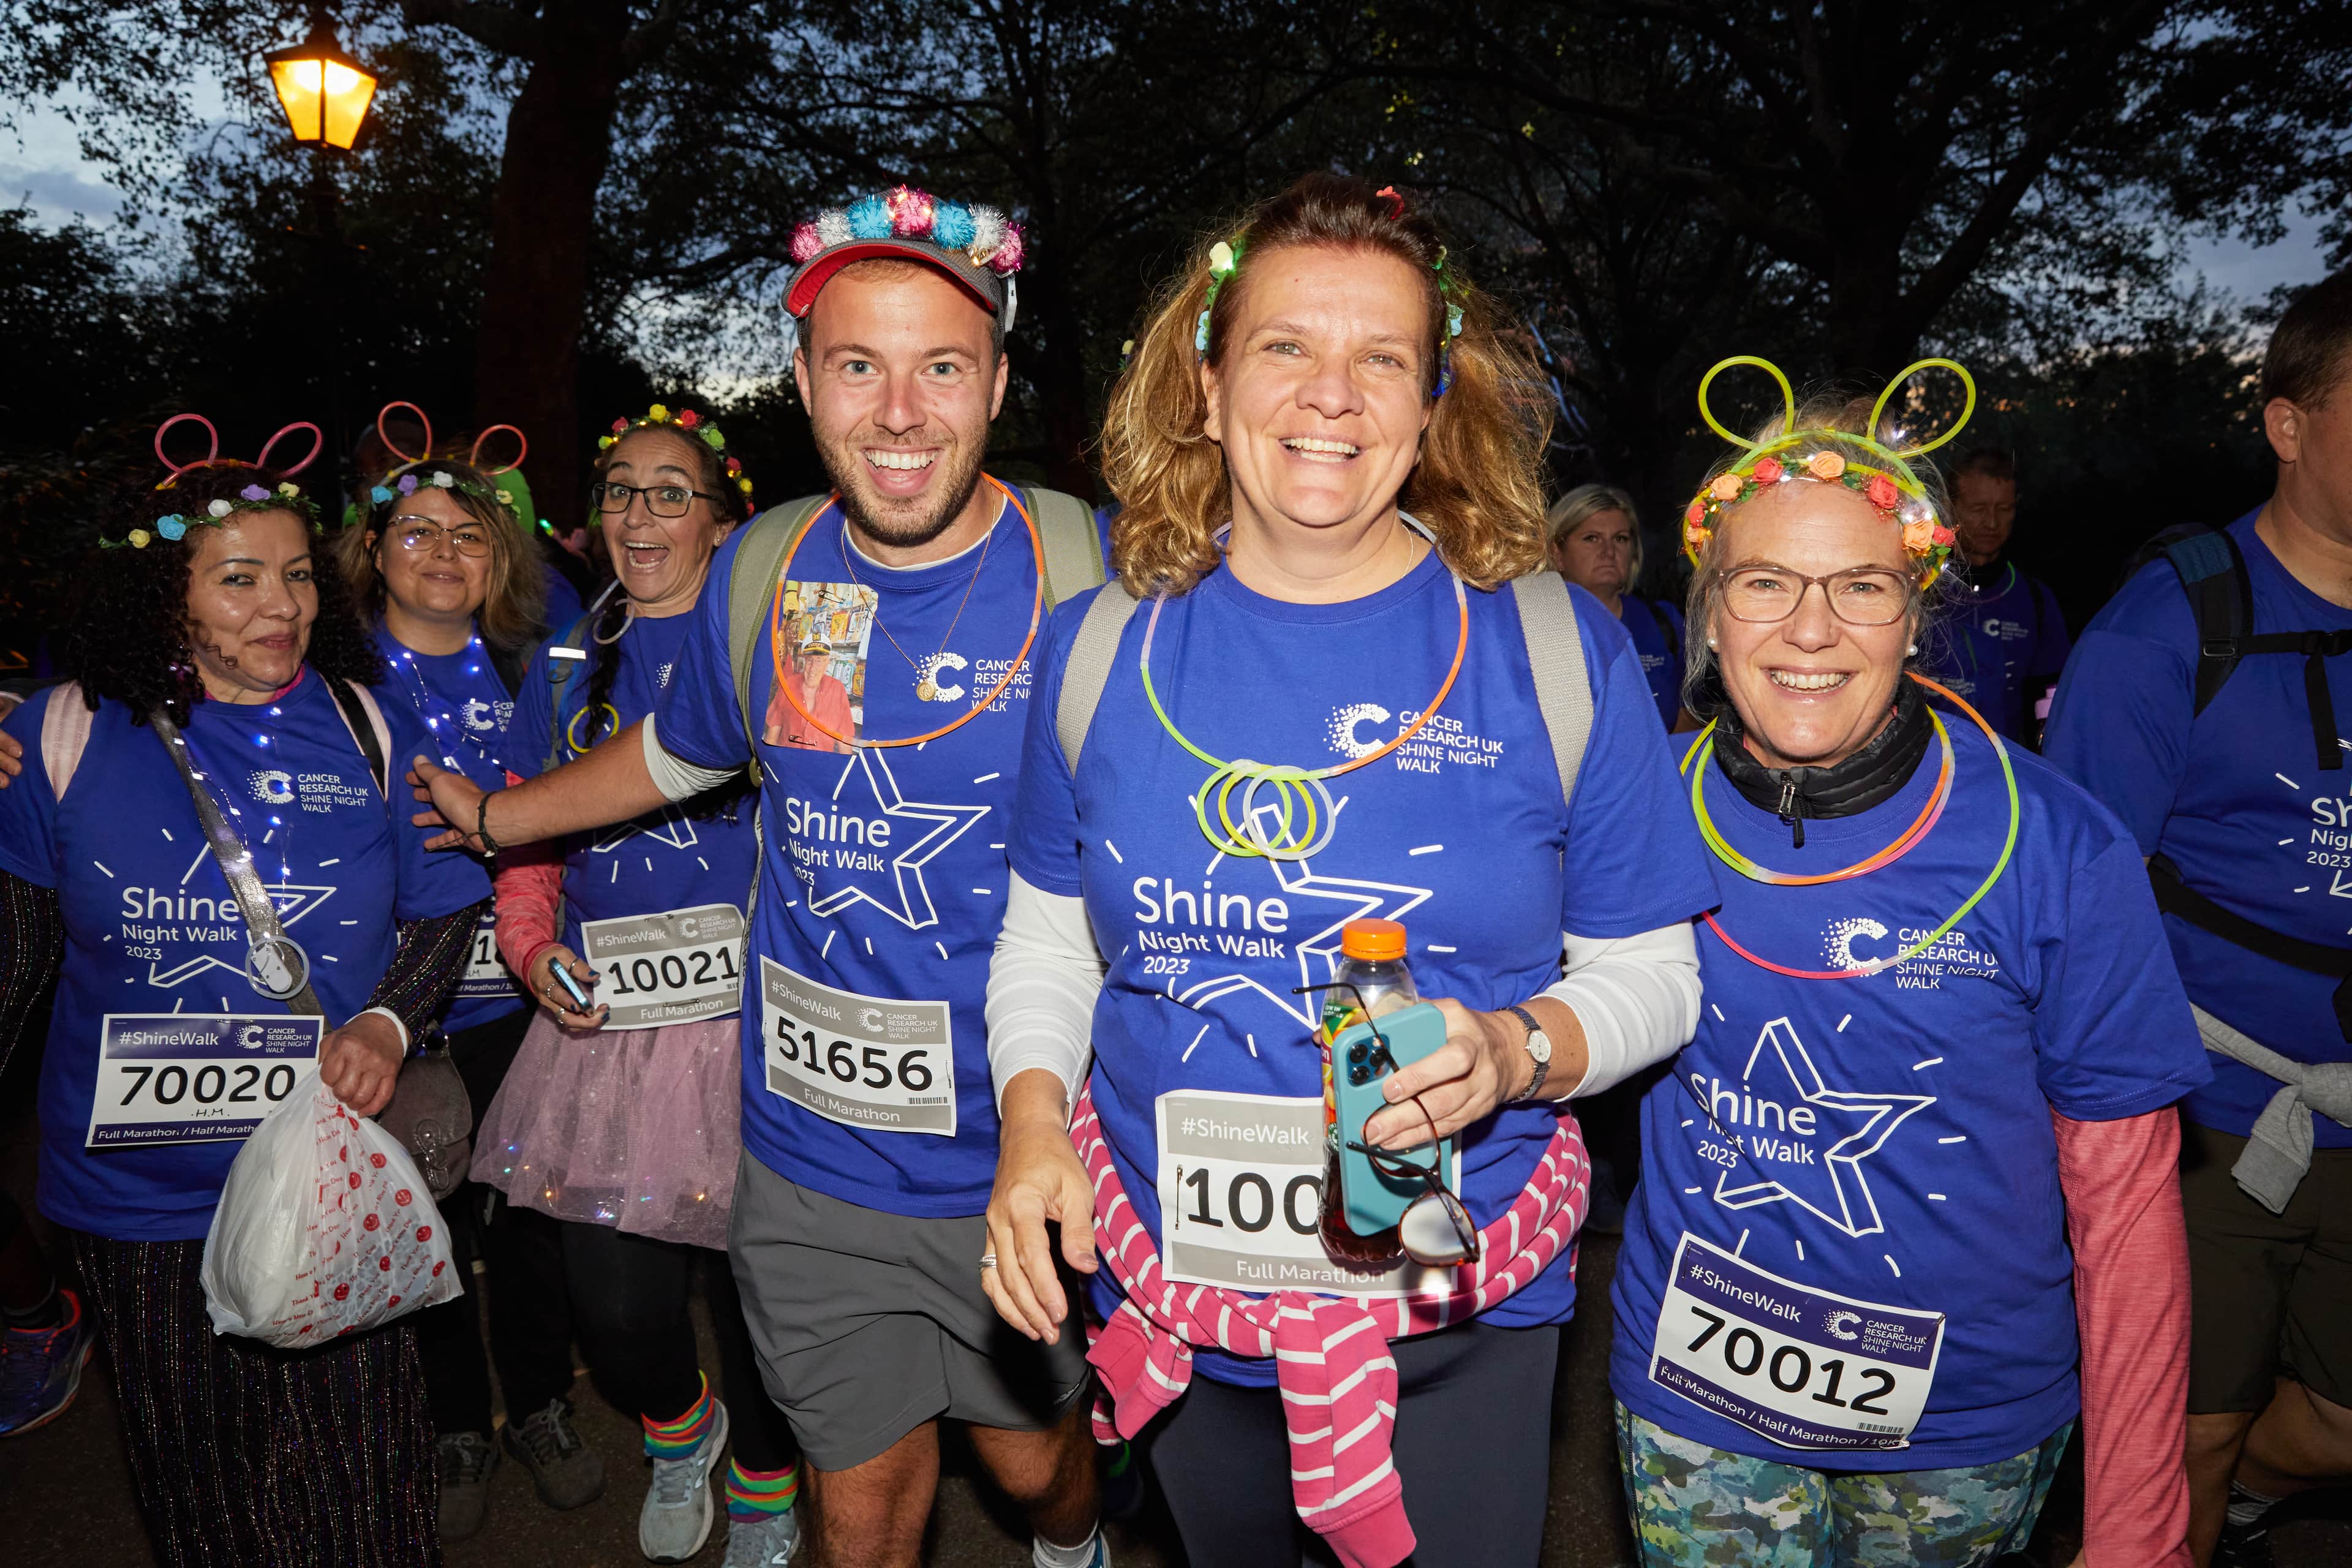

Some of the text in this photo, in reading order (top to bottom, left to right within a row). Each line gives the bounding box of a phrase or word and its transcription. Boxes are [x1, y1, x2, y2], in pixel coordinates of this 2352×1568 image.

[1396, 743, 1498, 767] SHINE NIGHT
[1482, 739, 1504, 753] UK
[1396, 758, 1440, 774] WALK
[298, 774, 341, 784] CANCER
[299, 784, 369, 796] RESEARCH UK
[301, 795, 366, 807] SHINE NIGHT
[301, 804, 332, 813] WALK
[786, 797, 891, 847] Shine
[2311, 829, 2352, 851] Nig
[789, 838, 884, 873] Night Walk
[2307, 851, 2351, 868] 2023
[122, 887, 239, 921] Shine
[1133, 876, 1289, 933] Shine
[122, 924, 237, 944] Night Walk
[596, 929, 667, 947] #ShineWalk
[124, 946, 162, 960] 2023
[1139, 930, 1285, 959] Night Walk
[1143, 956, 1191, 974] 2023
[1985, 953, 1999, 966] U
[608, 946, 739, 994] 10021
[1896, 962, 1999, 979] SHINE NIGHT
[1896, 976, 1940, 990] WALK
[641, 1000, 723, 1019] Full Marathon
[771, 979, 842, 1021] #ShineWalk
[119, 1031, 219, 1046] #ShineWalk
[777, 1016, 933, 1091] 51656
[120, 1065, 296, 1106] 70020
[804, 1088, 900, 1123] Full Marathon
[1691, 1073, 1817, 1136] Shine
[98, 1130, 122, 1139] Full
[190, 1126, 214, 1136] Half
[1181, 1117, 1309, 1145] #ShineWalk
[1697, 1140, 1738, 1168] 2023
[1752, 1136, 1814, 1164] Walk
[1236, 1260, 1384, 1283] Full Marathon
[1690, 1264, 1801, 1323] #ShineWalk
[1864, 1327, 1912, 1343] RESEARCH
[1866, 1321, 1905, 1333] CANCER
[1861, 1343, 1888, 1354] WALK
[1863, 1335, 1924, 1353] SHINE NIGHT
[1687, 1305, 1896, 1415] 70012
[1660, 1365, 1683, 1385] Full
[1685, 1379, 1746, 1416] Marathon
[1748, 1411, 1756, 1420] /
[1758, 1414, 1788, 1433] Half
[1789, 1425, 1856, 1445] Marathon
